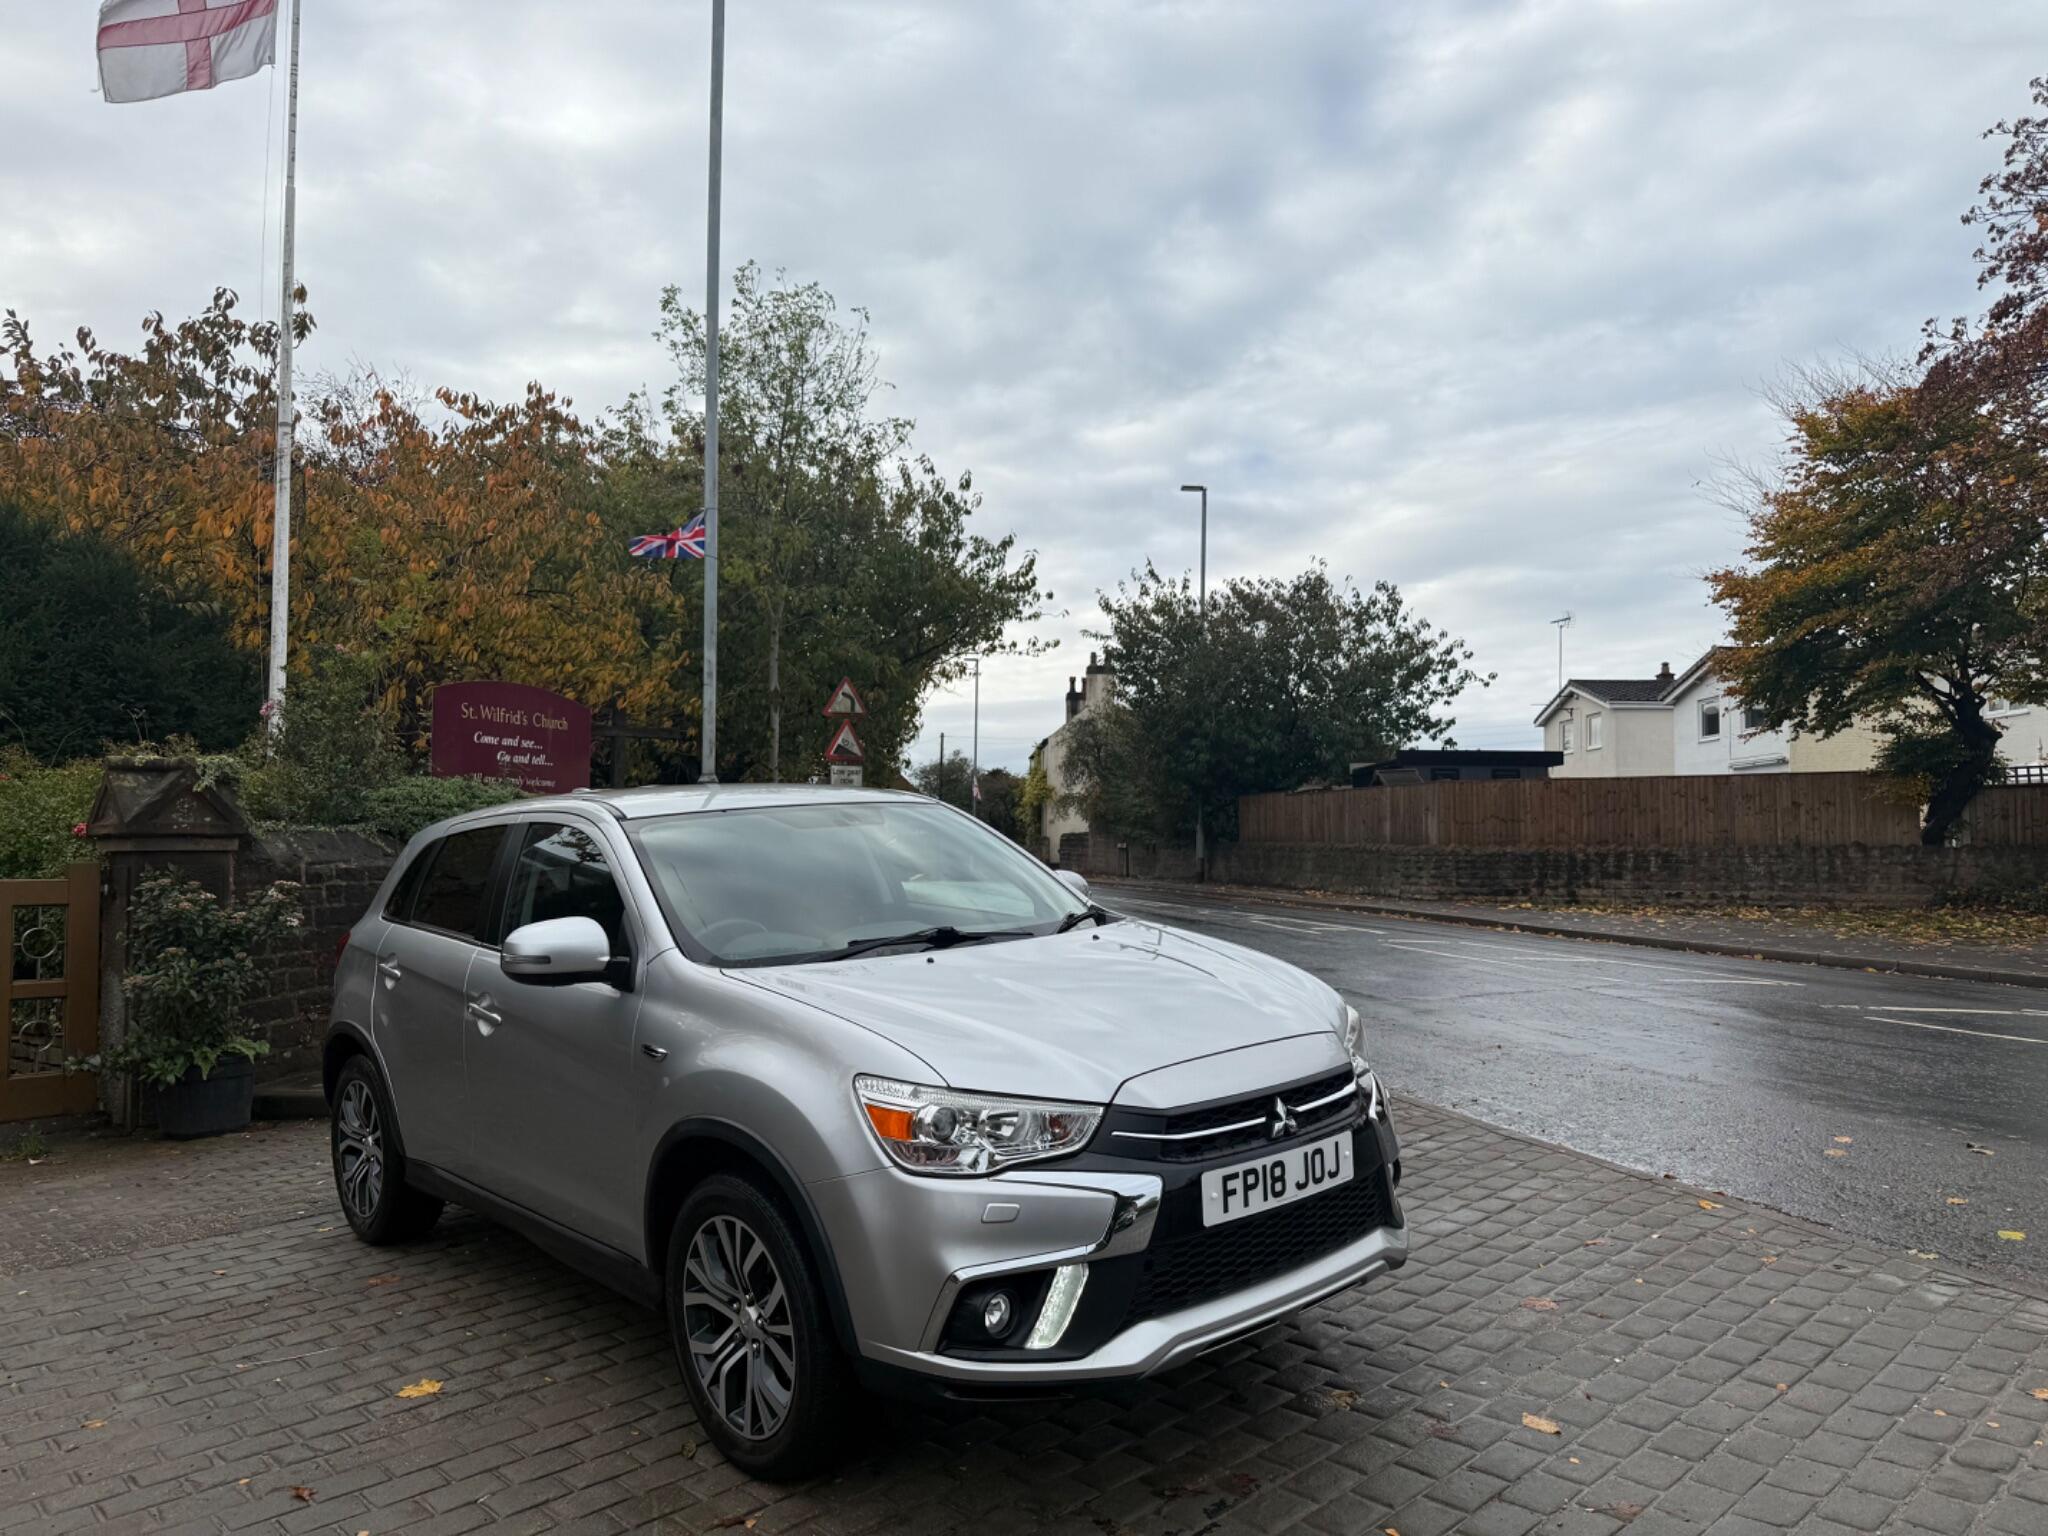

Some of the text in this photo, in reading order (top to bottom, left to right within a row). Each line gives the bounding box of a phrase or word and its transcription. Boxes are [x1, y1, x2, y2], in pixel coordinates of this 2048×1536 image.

[461, 702, 569, 731] St. Wilfrid's Church
[474, 731, 499, 746] Come
[501, 735, 520, 748] and
[512, 752, 530, 765] and
[1221, 1141, 1341, 1214] FP18 JOJ
